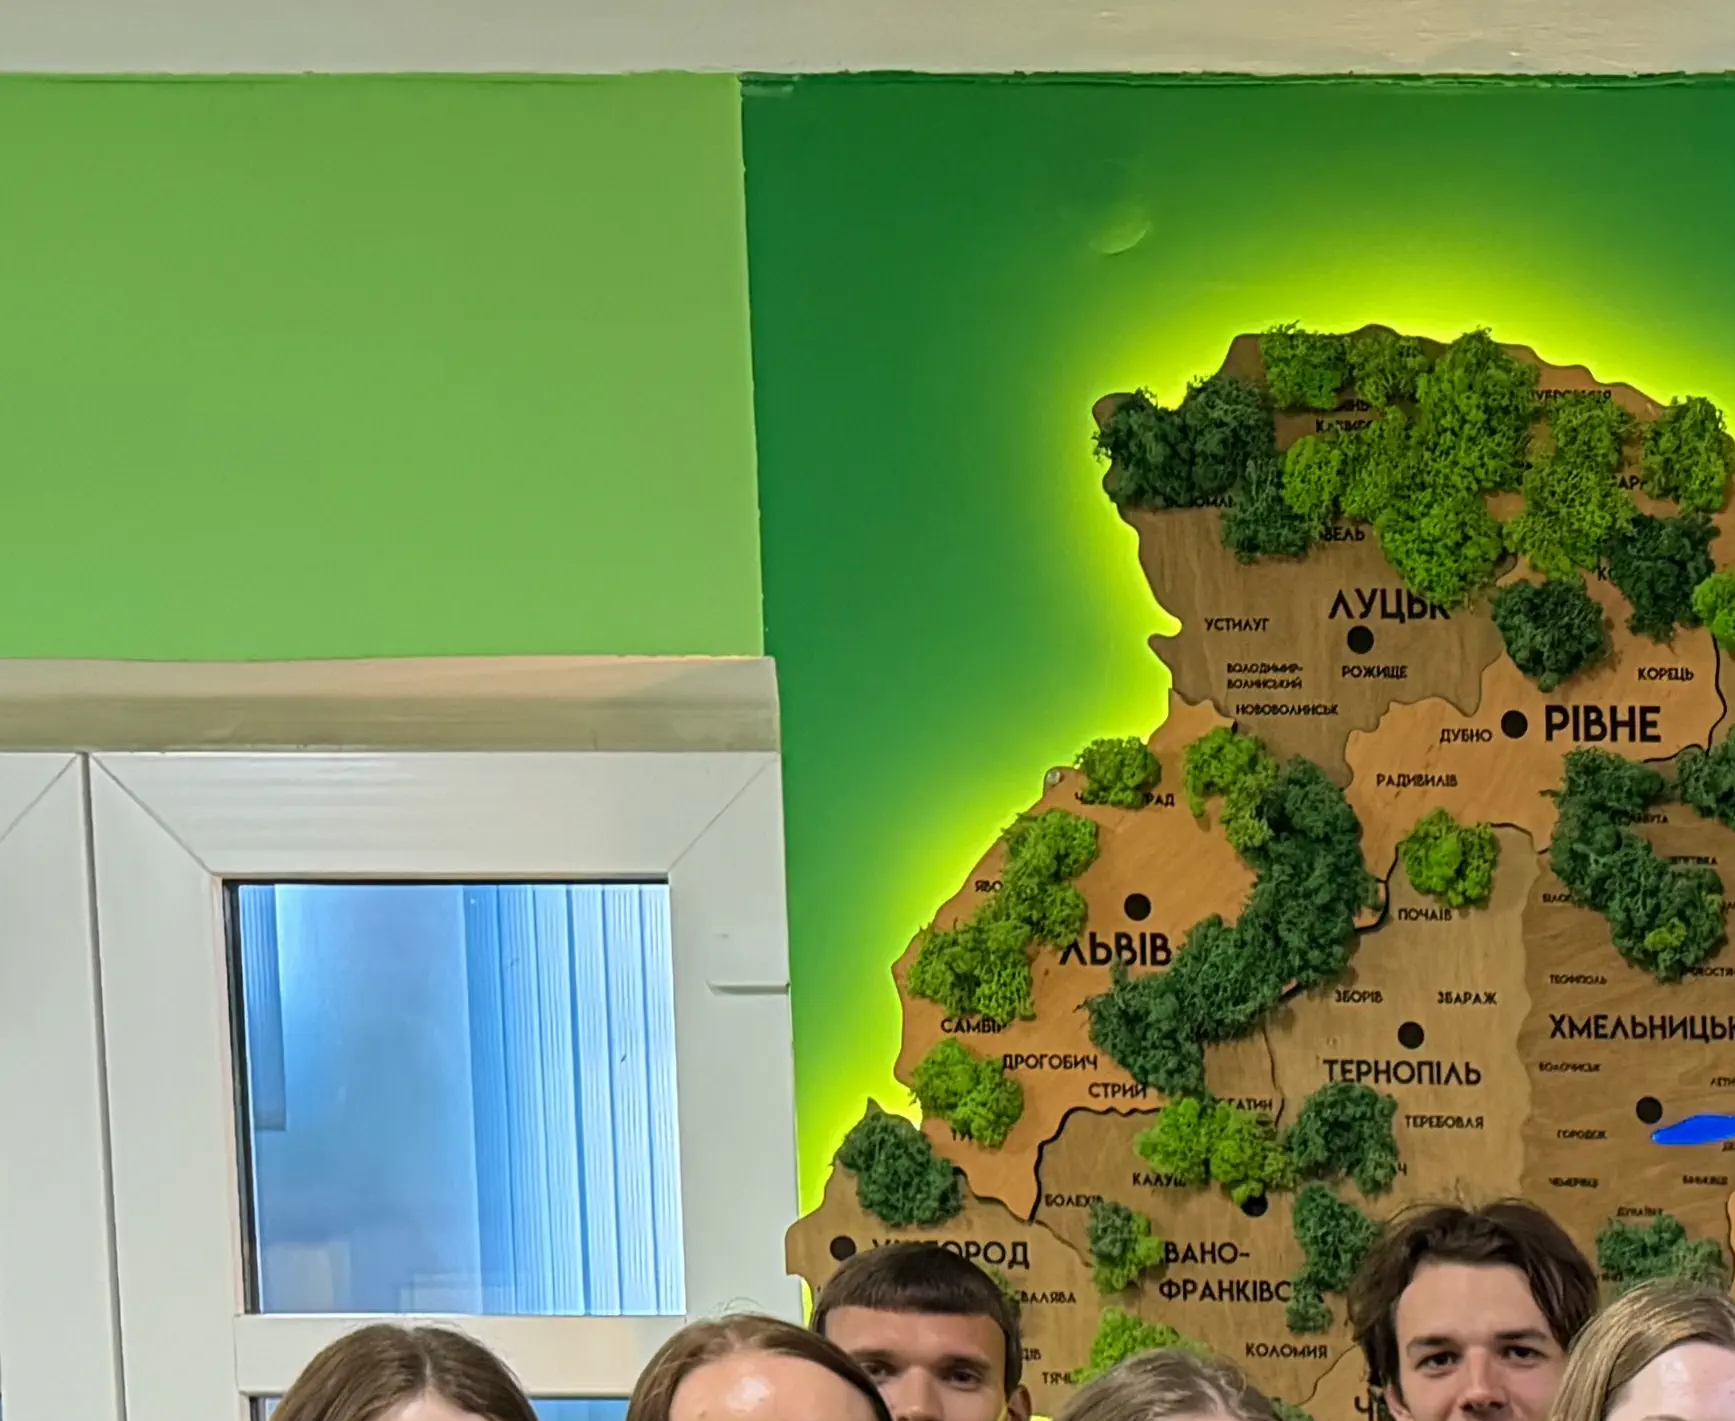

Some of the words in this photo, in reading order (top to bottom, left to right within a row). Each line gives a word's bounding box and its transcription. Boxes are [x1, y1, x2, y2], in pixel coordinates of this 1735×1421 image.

[1205, 618, 1270, 631] УСТИЛУГ
[1341, 665, 1408, 679] РОЖИЩЕ
[1638, 668, 1694, 683] КОРЕЦЬ
[1545, 705, 1661, 742] РІВНЕ
[1440, 729, 1492, 743] ДУБНО
[1376, 774, 1458, 788] РАДИВИЛІВ
[1059, 932, 1172, 966] ЛЬВІВ
[1335, 990, 1383, 1003] ЗБОРІВ
[1437, 991, 1497, 1004] ЗБАРАЖ
[1002, 1053, 1098, 1070] ДРОГОБИЧ
[1323, 1059, 1481, 1085] ТЕРНОПІЛЬ
[1405, 1116, 1484, 1129] ТЕРЕБОВЛЯ
[1246, 1343, 1327, 1358] КОЛОМИЯ
